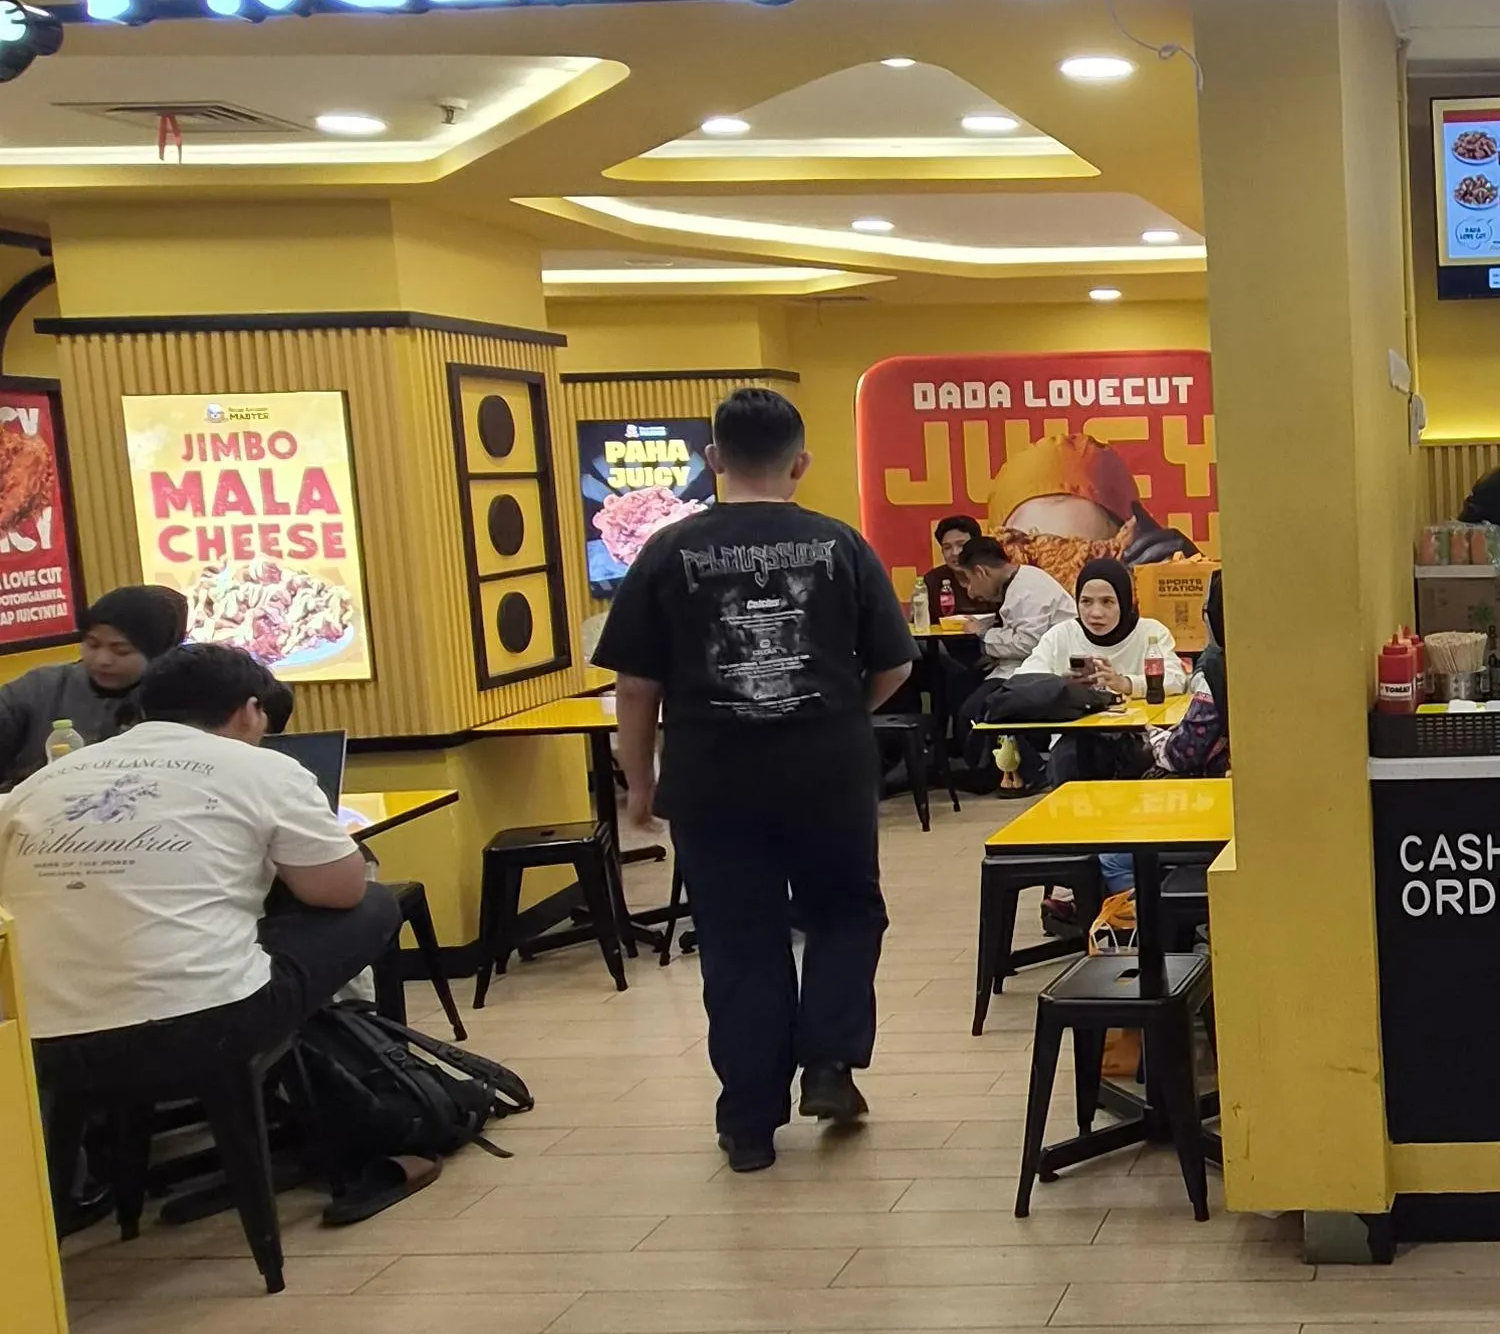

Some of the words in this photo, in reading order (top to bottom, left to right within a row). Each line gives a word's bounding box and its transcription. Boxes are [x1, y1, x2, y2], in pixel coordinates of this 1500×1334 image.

[913, 380, 1011, 410] DADA
[1024, 376, 1194, 408] LOVECUT
[182, 430, 298, 462] JIMBO
[604, 439, 690, 464] PAHA
[607, 466, 691, 489] JUICY
[150, 466, 342, 519] MALA
[157, 521, 347, 563] CHEESE
[4, 571, 38, 591] LOVE
[37, 566, 63, 586] CUT
[1158, 585, 1204, 593] STATION
[117, 758, 215, 777] LANCASTER
